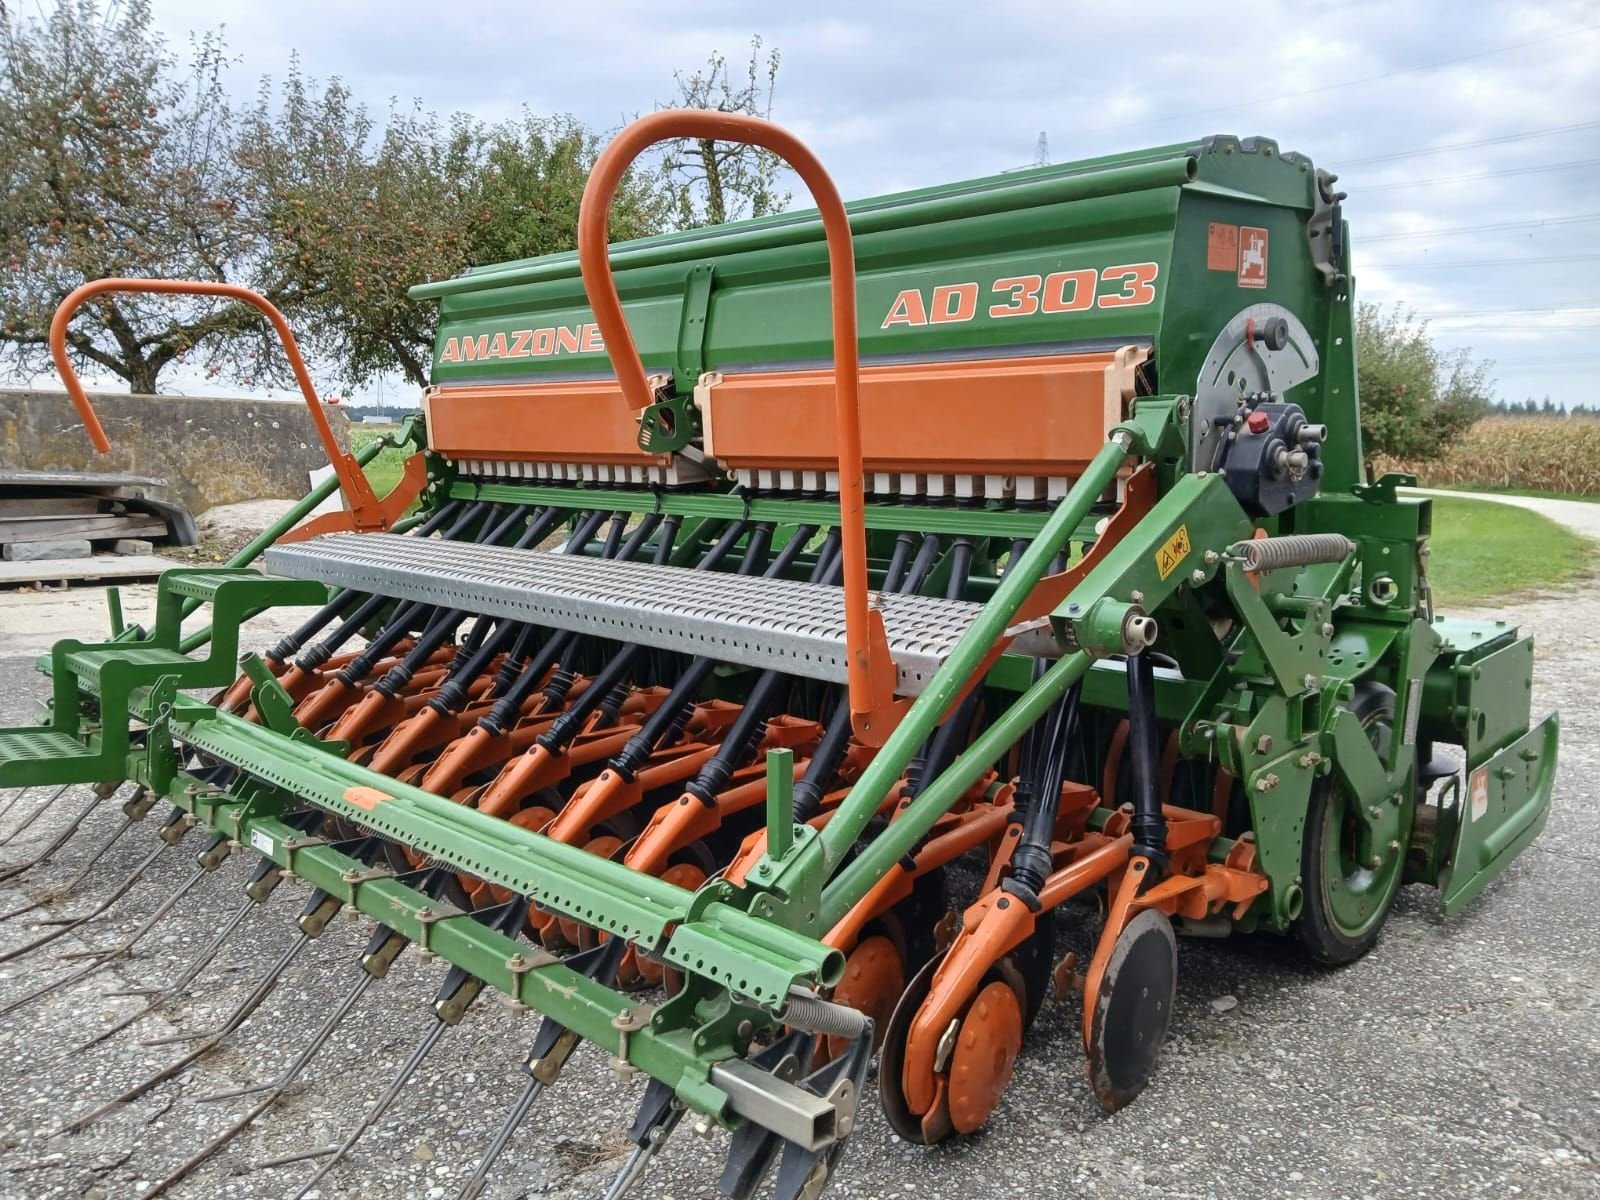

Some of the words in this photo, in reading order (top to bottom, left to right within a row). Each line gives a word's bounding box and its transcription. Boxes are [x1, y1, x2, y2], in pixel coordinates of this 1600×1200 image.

[880, 282, 979, 329] AD
[989, 262, 1159, 318] 303
[439, 322, 607, 363] AMAZONE
